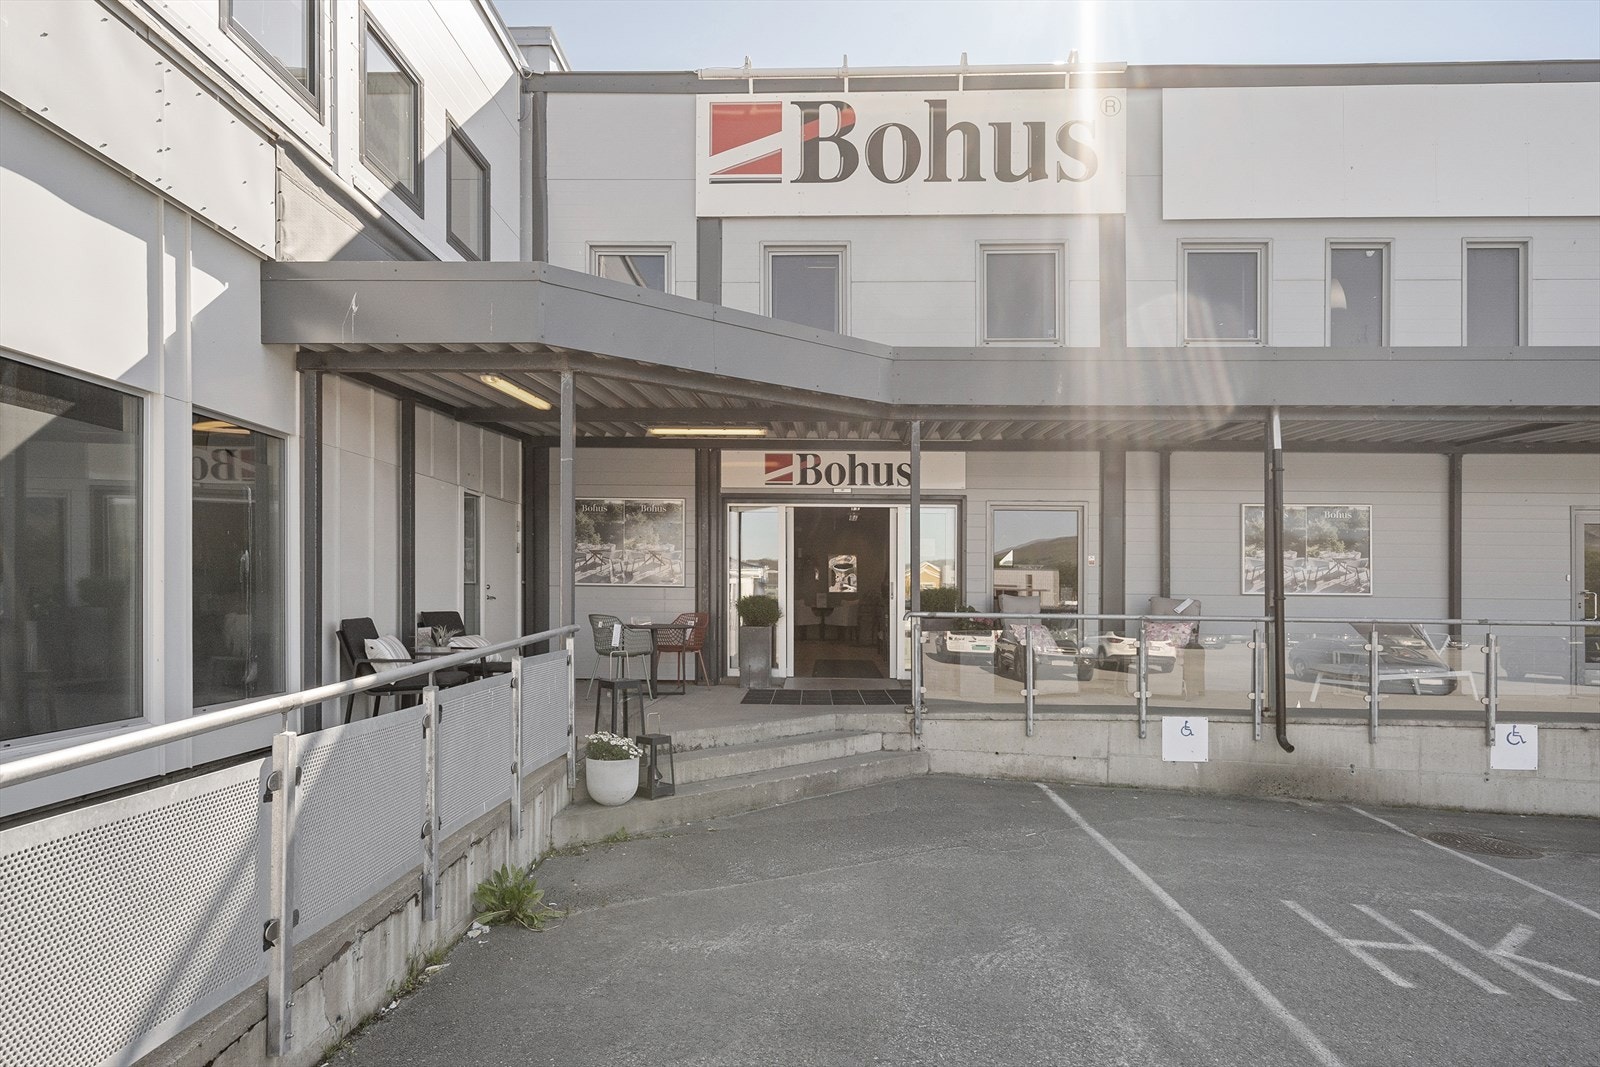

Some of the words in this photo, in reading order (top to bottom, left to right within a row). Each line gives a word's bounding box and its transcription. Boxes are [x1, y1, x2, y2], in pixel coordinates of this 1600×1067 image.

[790, 99, 1099, 184] Bohus
[796, 453, 911, 488] Bohus
[582, 504, 608, 512] Bohus
[641, 504, 667, 513] Bohus
[1324, 510, 1352, 519] Bohus
